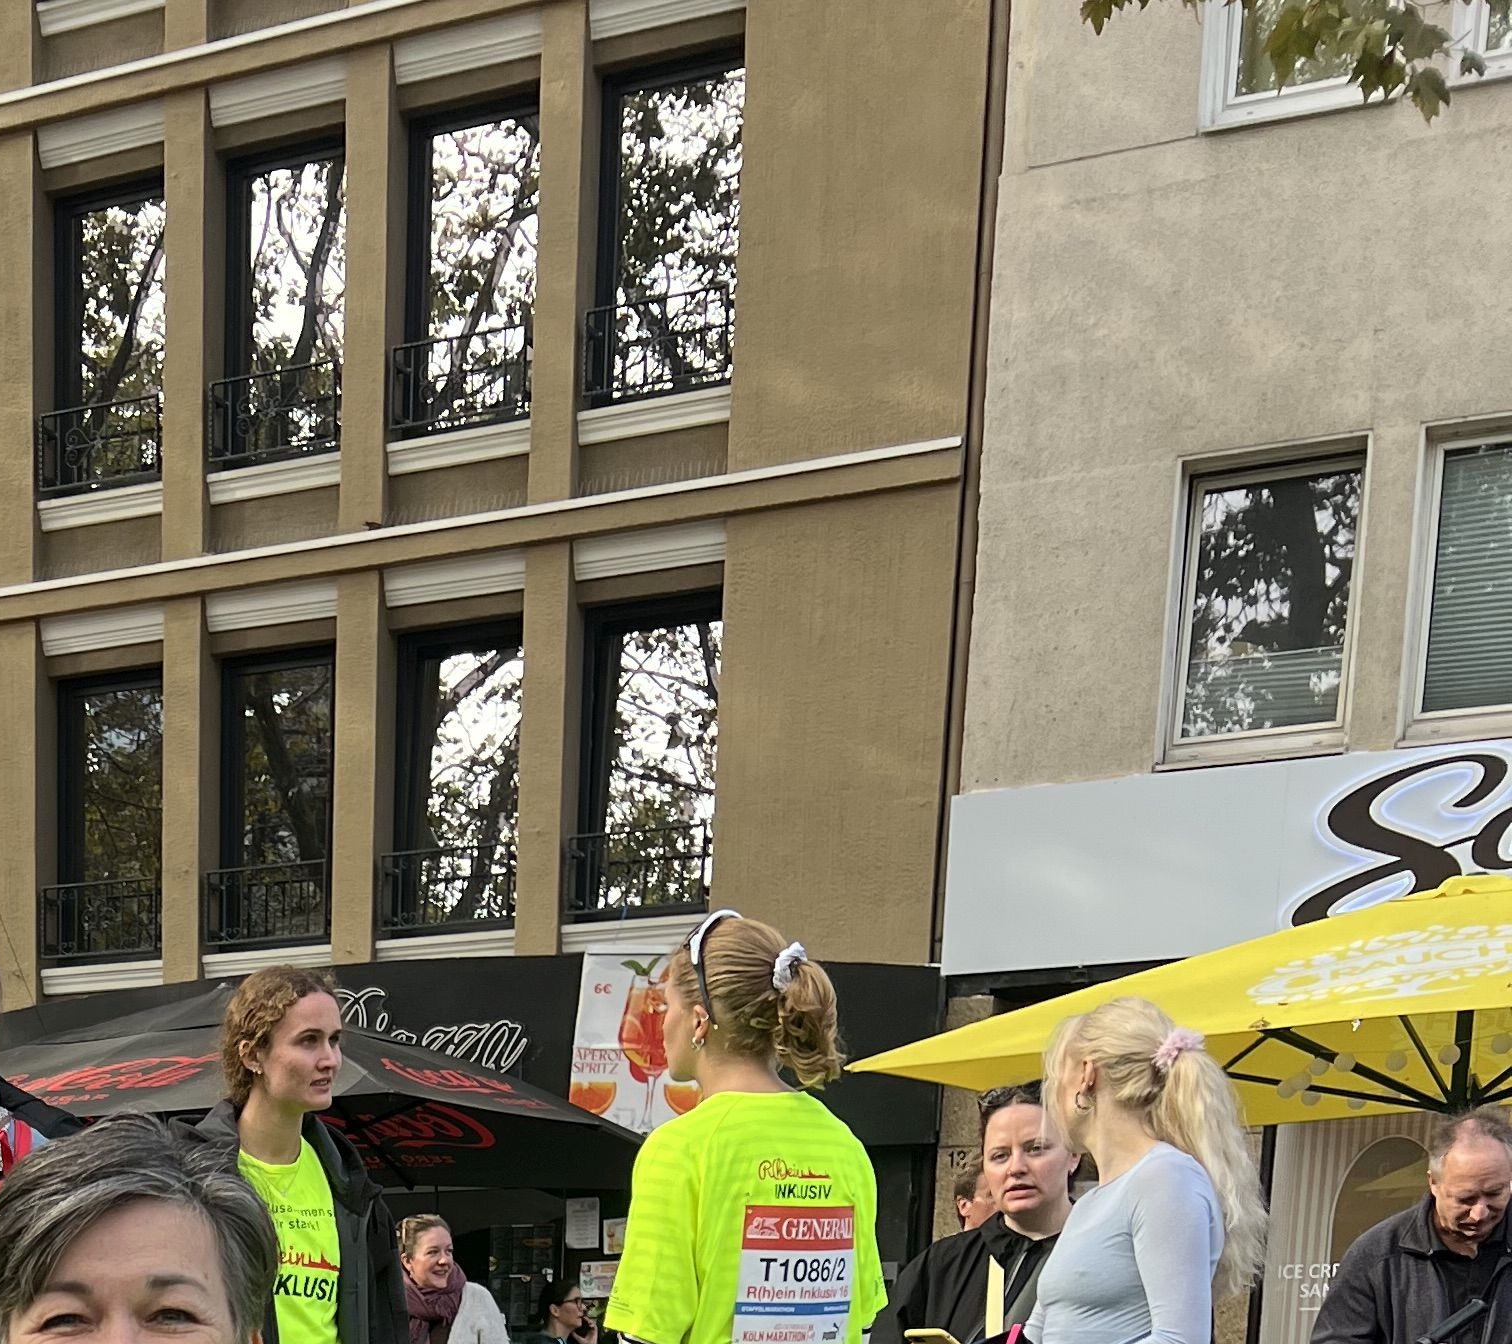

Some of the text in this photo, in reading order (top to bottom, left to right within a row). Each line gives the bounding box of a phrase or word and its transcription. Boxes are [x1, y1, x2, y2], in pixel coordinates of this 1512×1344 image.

[594, 983, 613, 995] 6€
[574, 1048, 624, 1062] APEROL
[572, 1062, 620, 1075] SPRITZ
[775, 1183, 832, 1200] INKLUSIV
[760, 1257, 846, 1282] T1086/2
[1278, 1263, 1304, 1279] ICE
[747, 1285, 796, 1301] R(h)ein
[742, 1330, 806, 1342] KÖLN MARATHON
